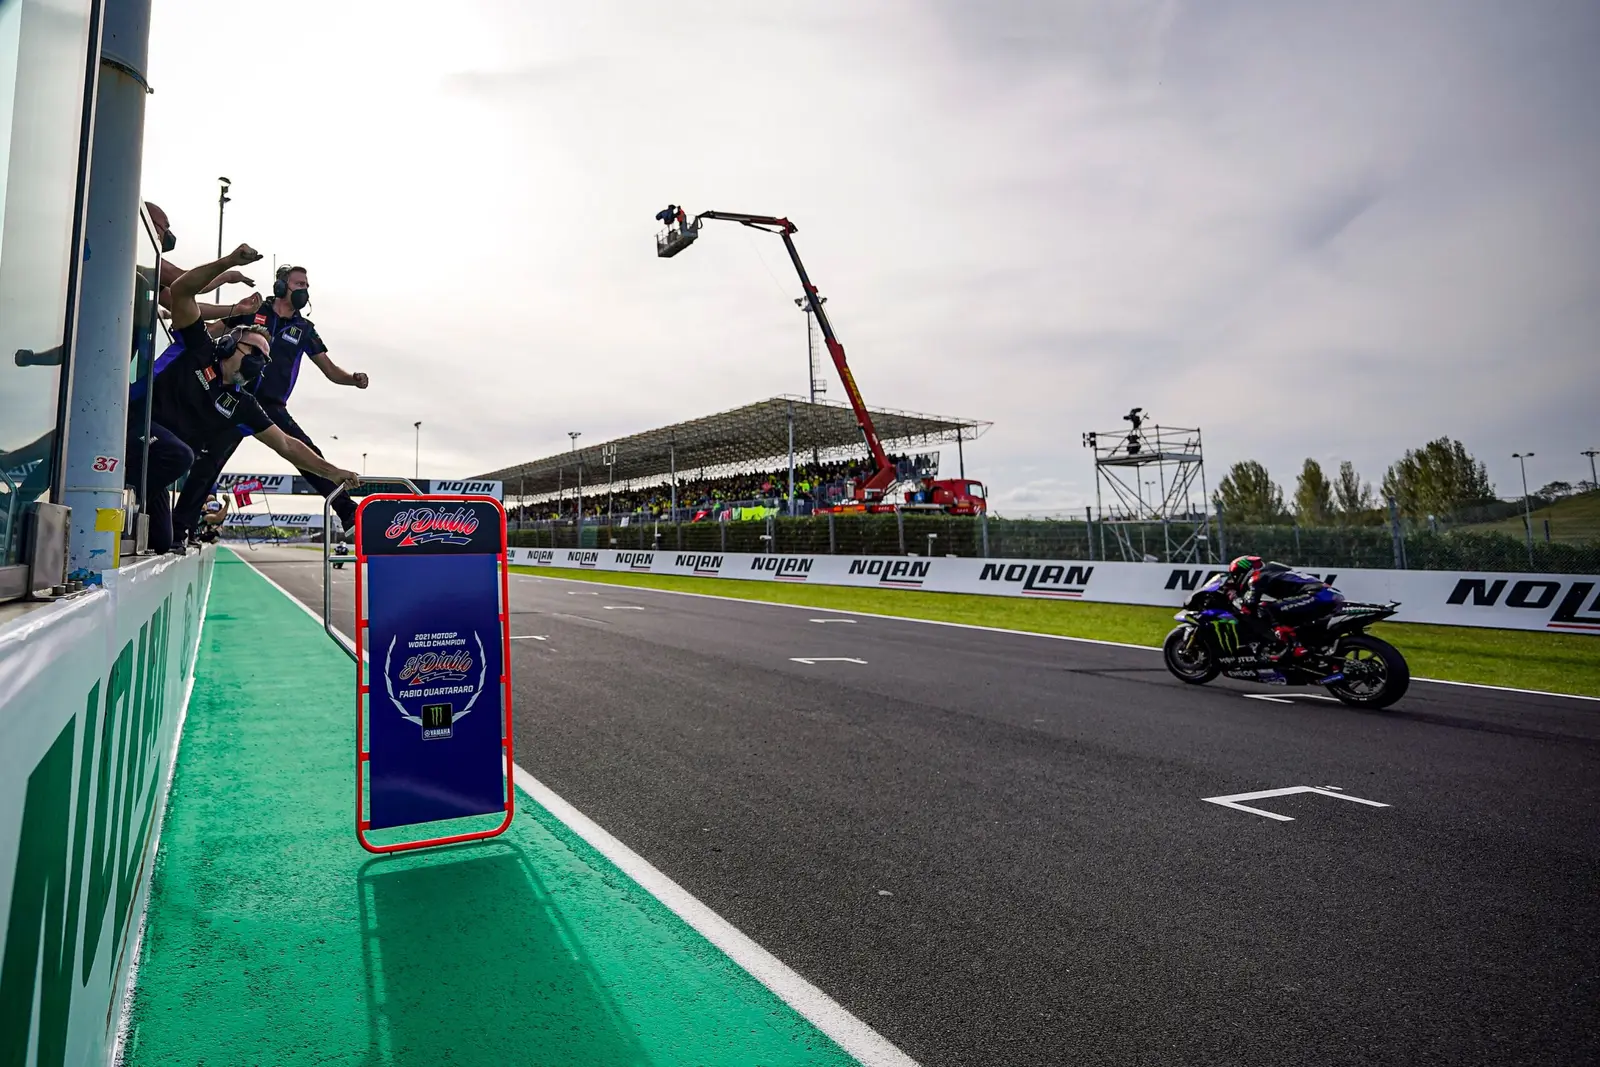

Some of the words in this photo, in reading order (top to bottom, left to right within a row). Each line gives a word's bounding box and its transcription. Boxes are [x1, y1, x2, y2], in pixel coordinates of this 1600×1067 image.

[92, 456, 119, 472] 37
[219, 475, 284, 491] NOAN
[437, 481, 495, 495] NOLAN
[271, 515, 311, 525] NOLAN
[385, 508, 414, 539] El
[411, 506, 479, 535] Diablo
[527, 550, 554, 564] NOLAN
[567, 551, 599, 566] NOLAN
[615, 552, 654, 569] NOLAN
[675, 554, 724, 573] NOLAN
[750, 557, 814, 578] NOLAN
[848, 560, 931, 584] NOLAN
[979, 563, 1094, 594] NOLAN
[1446, 578, 1600, 623] NOL
[408, 641, 432, 649] WORLD
[432, 639, 466, 647] CHAMPION
[414, 633, 431, 641] 2021
[431, 632, 457, 640] MOTOGP
[419, 649, 473, 673] Diablo
[399, 689, 423, 698] FABIO
[423, 685, 474, 697] QUARTARARO
[430, 728, 451, 736] YAMAHA
